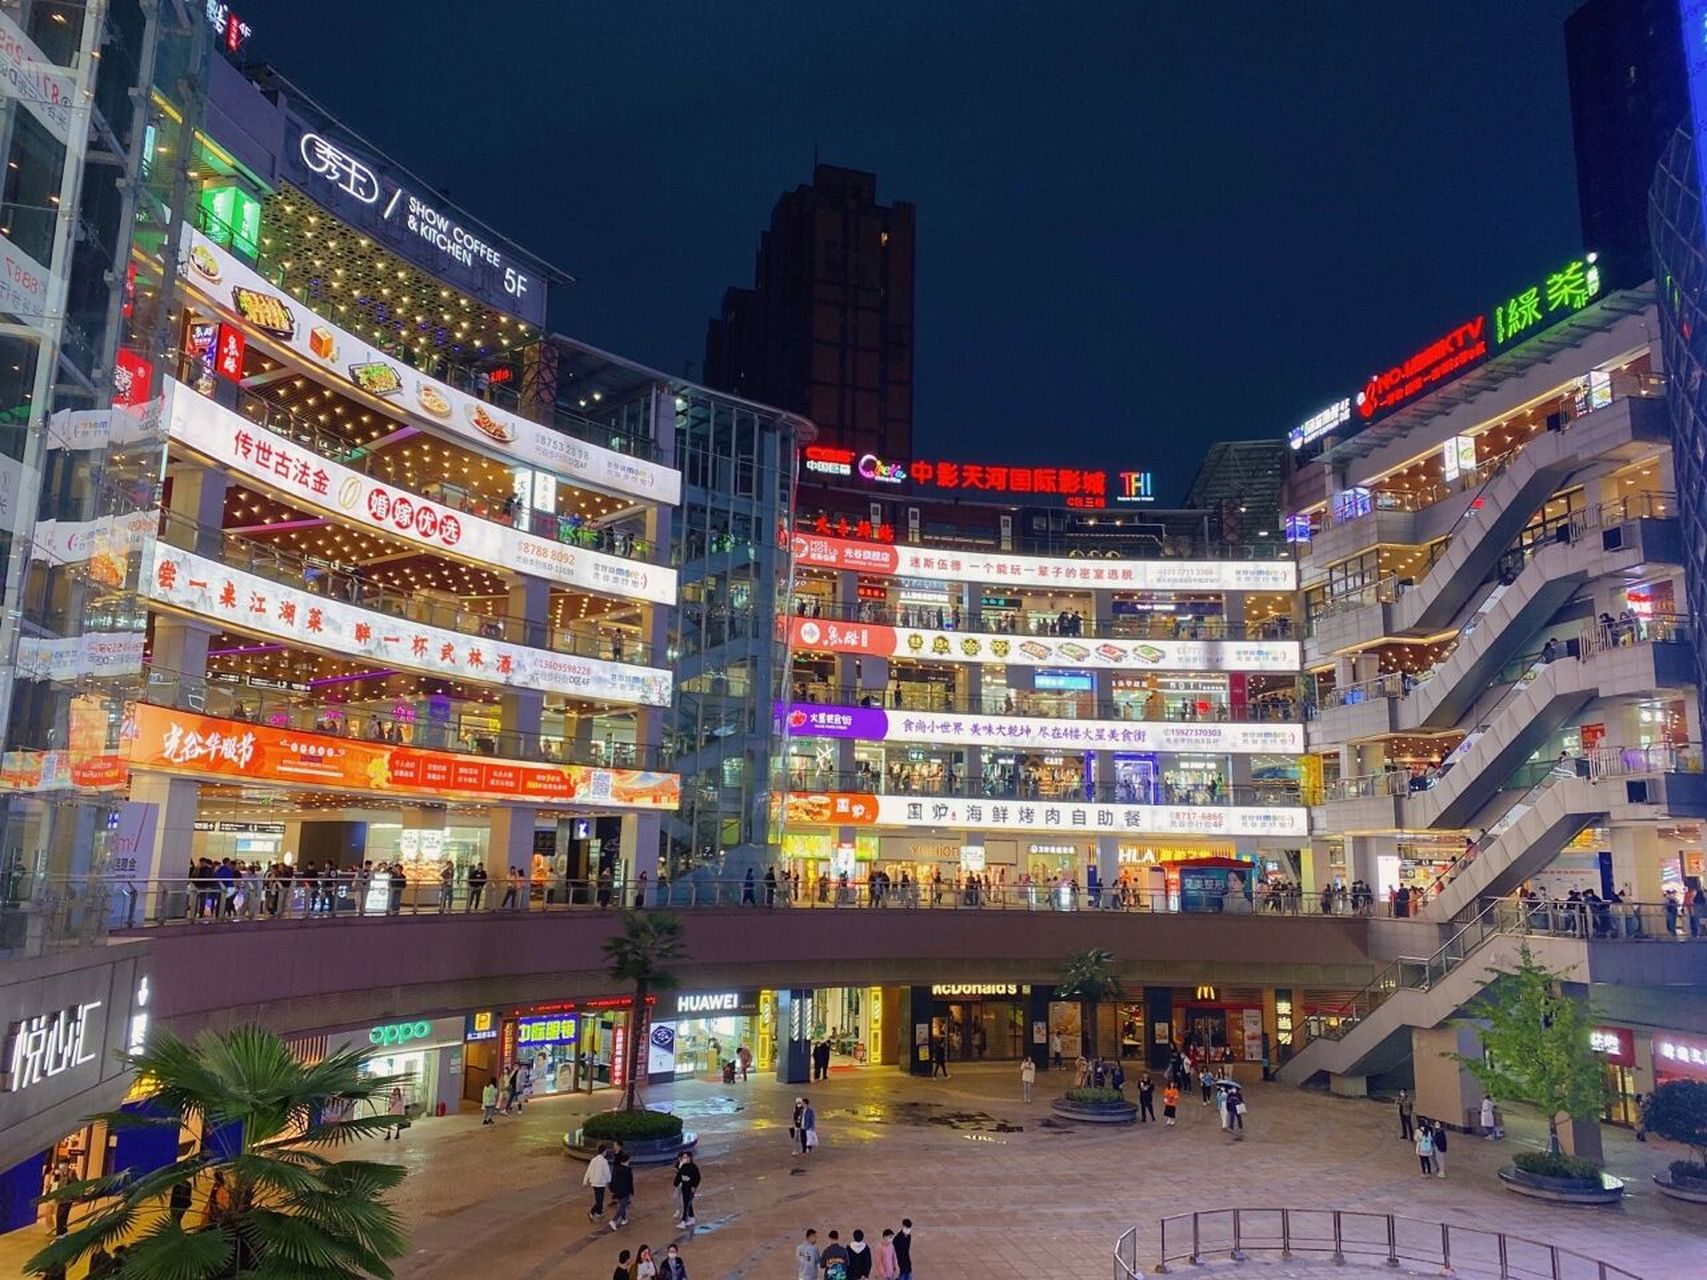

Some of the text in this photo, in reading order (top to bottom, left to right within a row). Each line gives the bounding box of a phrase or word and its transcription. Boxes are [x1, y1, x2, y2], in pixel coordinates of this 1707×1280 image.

[408, 196, 501, 268] SHOW COFFEE
[419, 222, 473, 267] KITCHEN
[503, 267, 528, 298] 5F
[234, 430, 461, 544] 传世古法金 婚嫁优选
[911, 461, 1107, 494] 中影天河国际影城
[903, 718, 965, 735] 食尚小世界
[966, 804, 1141, 827] 海鲜烤肉自助餐
[1118, 847, 1156, 863] HLA
[677, 993, 739, 1013] HUAWEI
[11, 1001, 102, 1092] 悦心汇
[369, 1021, 432, 1046] oppo
